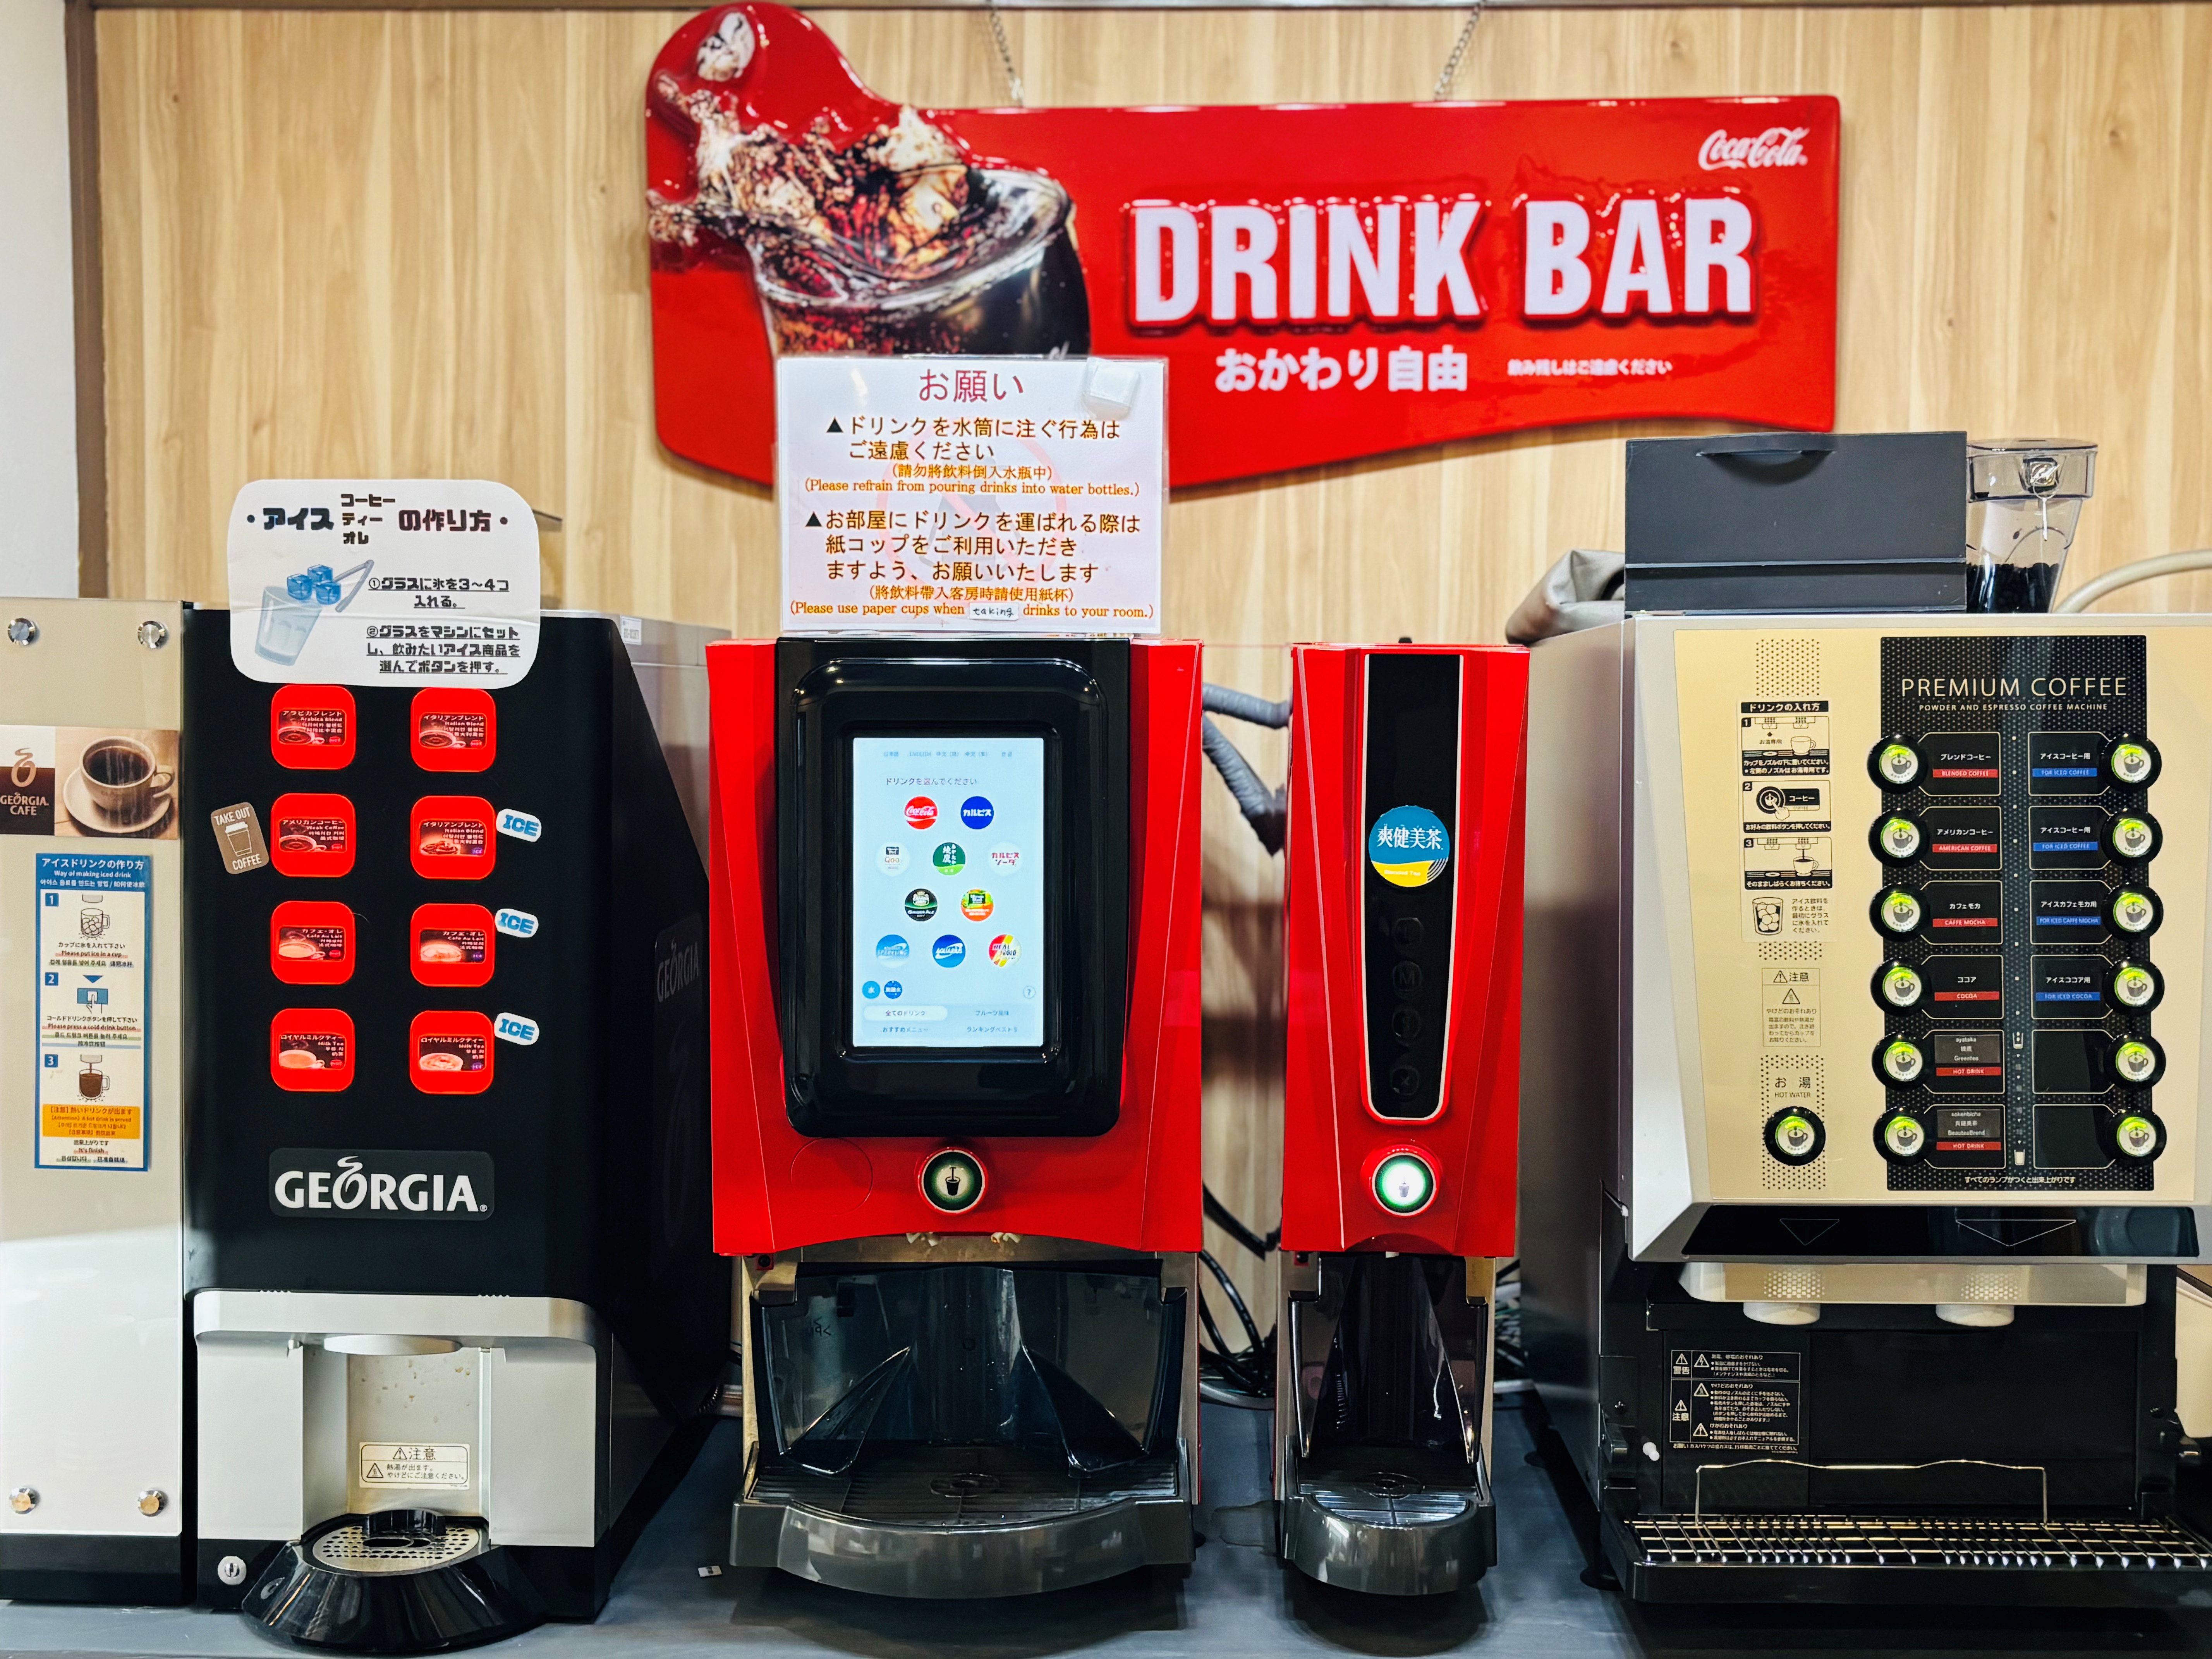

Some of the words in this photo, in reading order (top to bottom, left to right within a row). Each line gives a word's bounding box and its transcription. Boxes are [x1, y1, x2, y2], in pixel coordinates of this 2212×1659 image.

[1135, 199, 1481, 321] DRINK
[1525, 198, 1755, 314] BAR
[1216, 347, 1468, 391] おかわり自由
[1508, 358, 1673, 376] 飲み残しはご遠慮ください
[919, 369, 1024, 402] お願い
[850, 441, 994, 460] ご遠慮ください
[805, 478, 848, 493] (Please
[853, 479, 893, 491] refrain
[897, 480, 924, 492] from
[929, 480, 975, 495] pouring
[980, 481, 1017, 493] drinks
[1022, 482, 1045, 494] into
[1050, 483, 1084, 495] water
[1088, 483, 1140, 497] bottles.)
[341, 494, 395, 507] コーヒー
[342, 513, 382, 525] ティー
[343, 532, 369, 544] オレ
[826, 535, 1075, 555] 紙コップをご利用いただき
[827, 561, 1098, 582] ますよう、お願いいたします
[414, 595, 460, 608] 入れる。
[791, 601, 833, 615] (Please
[837, 605, 859, 614] use
[862, 604, 897, 617] paper
[901, 604, 930, 618] cups
[934, 602, 964, 615] when
[972, 605, 1014, 618] taking
[1023, 604, 1060, 617] drinks
[1065, 606, 1077, 617] to
[1082, 607, 1108, 620] your
[1111, 605, 1154, 619] room.)
[368, 643, 520, 656] し、飲みたいアイス商品を
[380, 660, 501, 673] 選んでボタンを押す。
[1902, 678, 2020, 696] PREMIUM
[2032, 677, 2127, 696] COFFEE
[1750, 703, 1820, 712] ドリンクの入れ方
[10, 805, 37, 816] CAFE
[215, 811, 234, 824] TAKE
[236, 807, 251, 819] OUT
[503, 814, 539, 837] ICE
[1377, 825, 1443, 850] 爽健美茶
[42, 859, 144, 870] アイスドリンクの作り方
[232, 854, 261, 870] COFFEE
[49, 895, 53, 905] 1
[498, 912, 534, 934] ICE
[48, 974, 54, 984] 2
[1790, 972, 1809, 982] 注意
[499, 1018, 535, 1040] ICE
[48, 1056, 54, 1065] 3
[275, 1156, 479, 1211] GEORGIA
[1673, 1413, 1689, 1421] 注意
[409, 1447, 436, 1460] 注意
